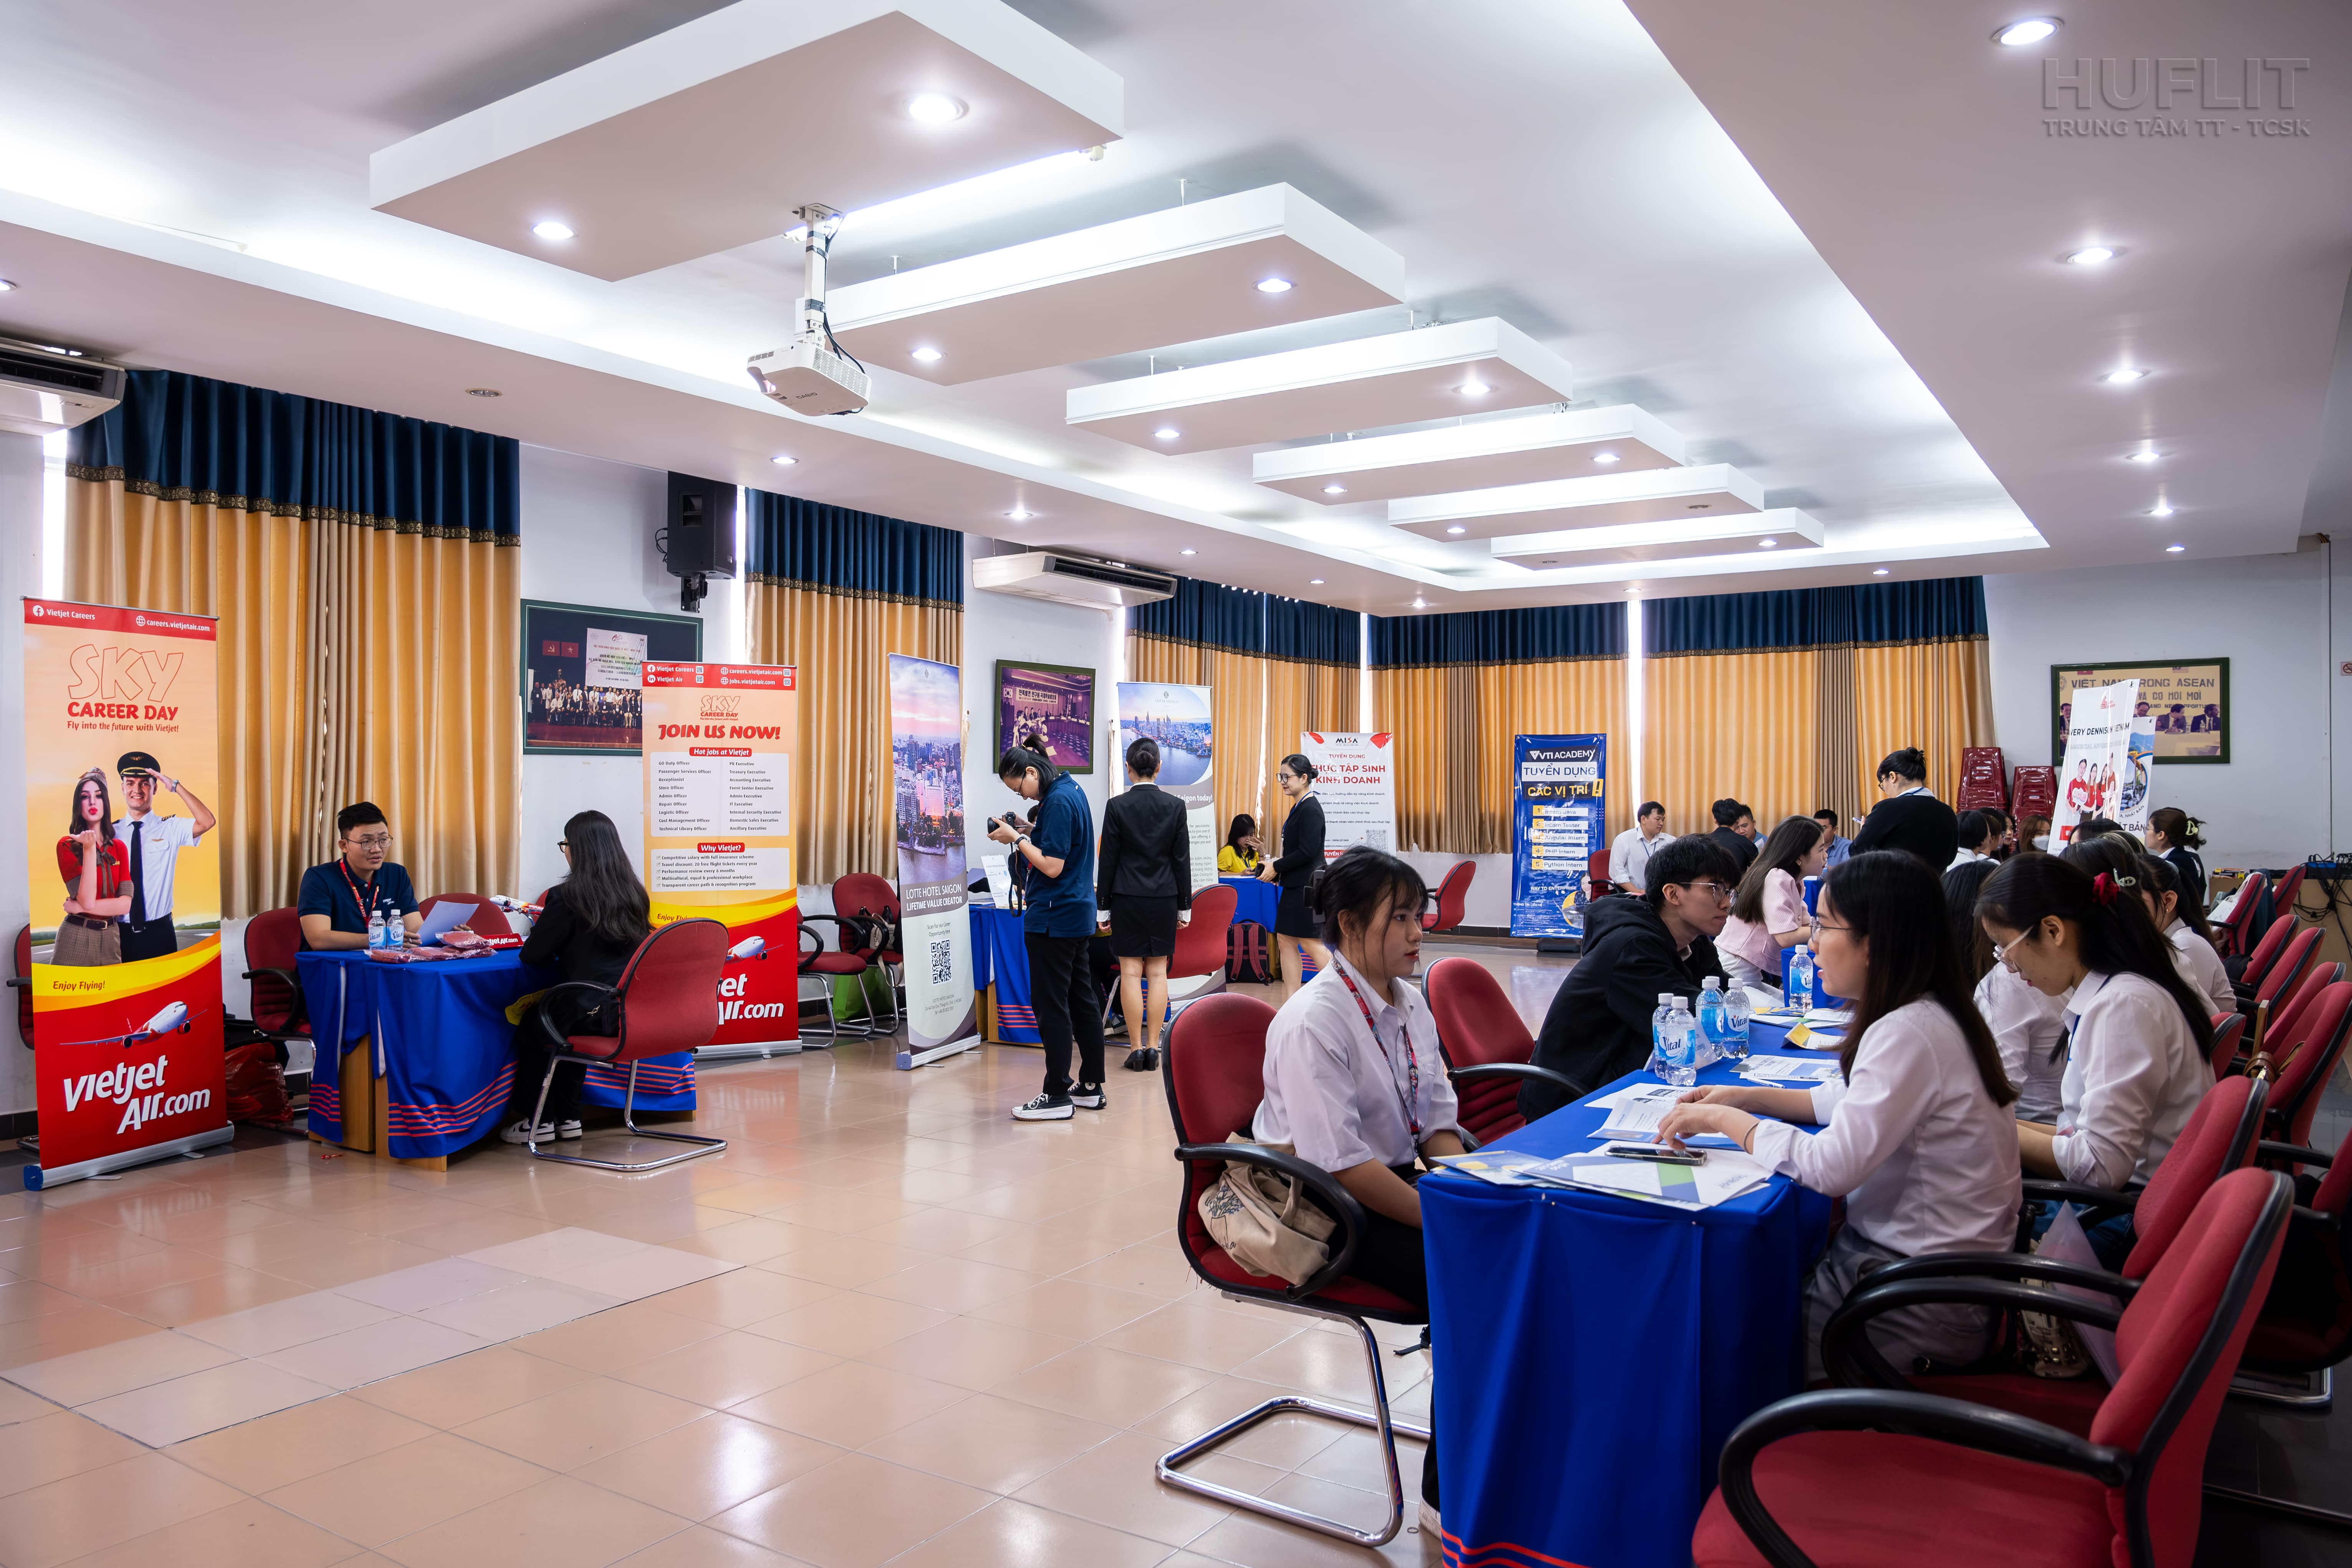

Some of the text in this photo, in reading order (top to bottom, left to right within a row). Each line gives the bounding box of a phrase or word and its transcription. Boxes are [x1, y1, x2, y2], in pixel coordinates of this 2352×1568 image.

[47, 609, 95, 620] Vietjet Careers
[147, 619, 210, 632] careers.vietjetair.com
[68, 644, 184, 702] SKY
[2177, 678, 2214, 687] ASEAN
[68, 702, 178, 720] CAREER DAY
[701, 695, 740, 712] SKY
[67, 721, 79, 730] Fly
[82, 721, 97, 729] into
[111, 723, 133, 731] future
[155, 724, 179, 733] Vietjet!
[658, 724, 780, 740] JOIN US NOW!
[1554, 750, 1595, 759] ACADEMY
[1339, 763, 1359, 774] TẬP
[1524, 763, 1596, 778] TUYỂN DỤNG
[1555, 786, 1565, 798] VỊ
[1569, 782, 1588, 795] TRÍ
[1197, 794, 1212, 803] today!
[906, 883, 962, 899] LOTTE HOTEL SAIGON
[907, 896, 962, 911] LIFETIME VALUE CREATOR
[369, 932, 381, 941] Vital
[53, 980, 105, 991] Enjoy Flying!
[1731, 1015, 1747, 1028] Vital
[1663, 1036, 1681, 1051] Vital
[64, 1055, 168, 1112] Vietjet
[117, 1089, 210, 1134] Air.com
